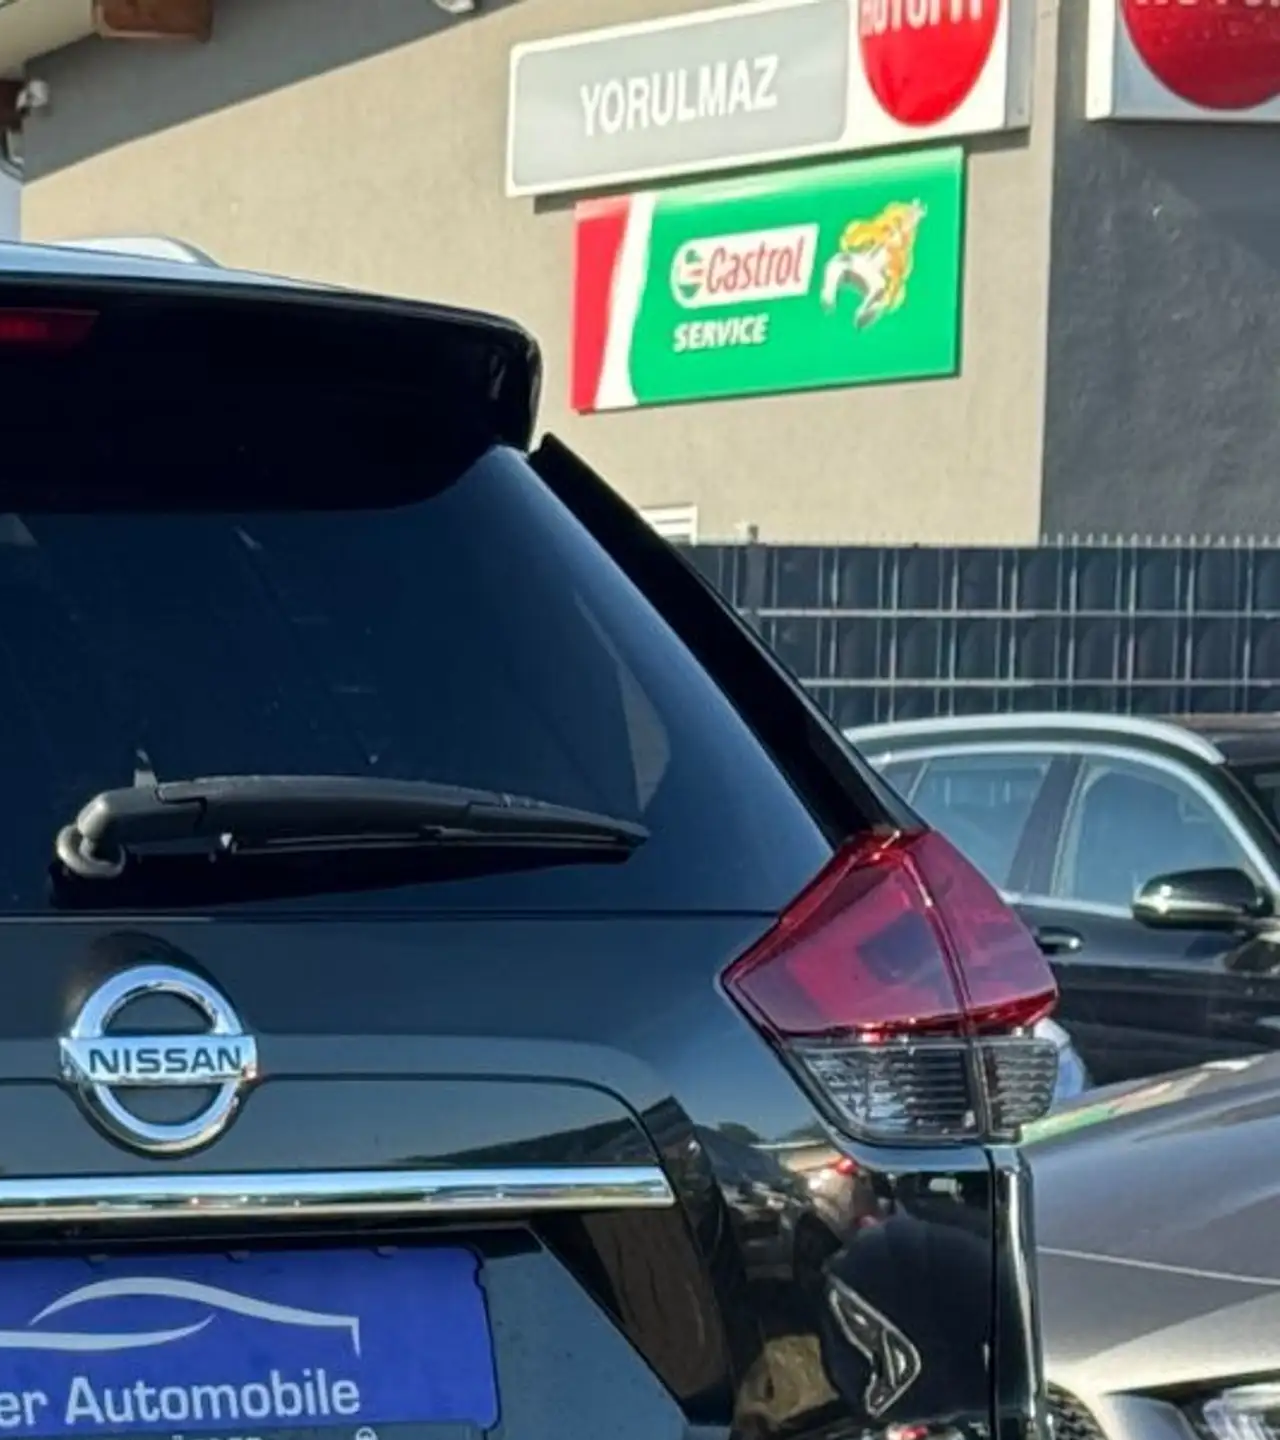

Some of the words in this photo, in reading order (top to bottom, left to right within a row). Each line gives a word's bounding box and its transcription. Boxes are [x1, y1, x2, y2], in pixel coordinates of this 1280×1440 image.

[579, 53, 779, 137] YORULMAZ
[705, 234, 806, 295] Castrol
[673, 312, 769, 353] SERVICE
[90, 1047, 241, 1075] NISSAN
[65, 1367, 360, 1426] Automobile
